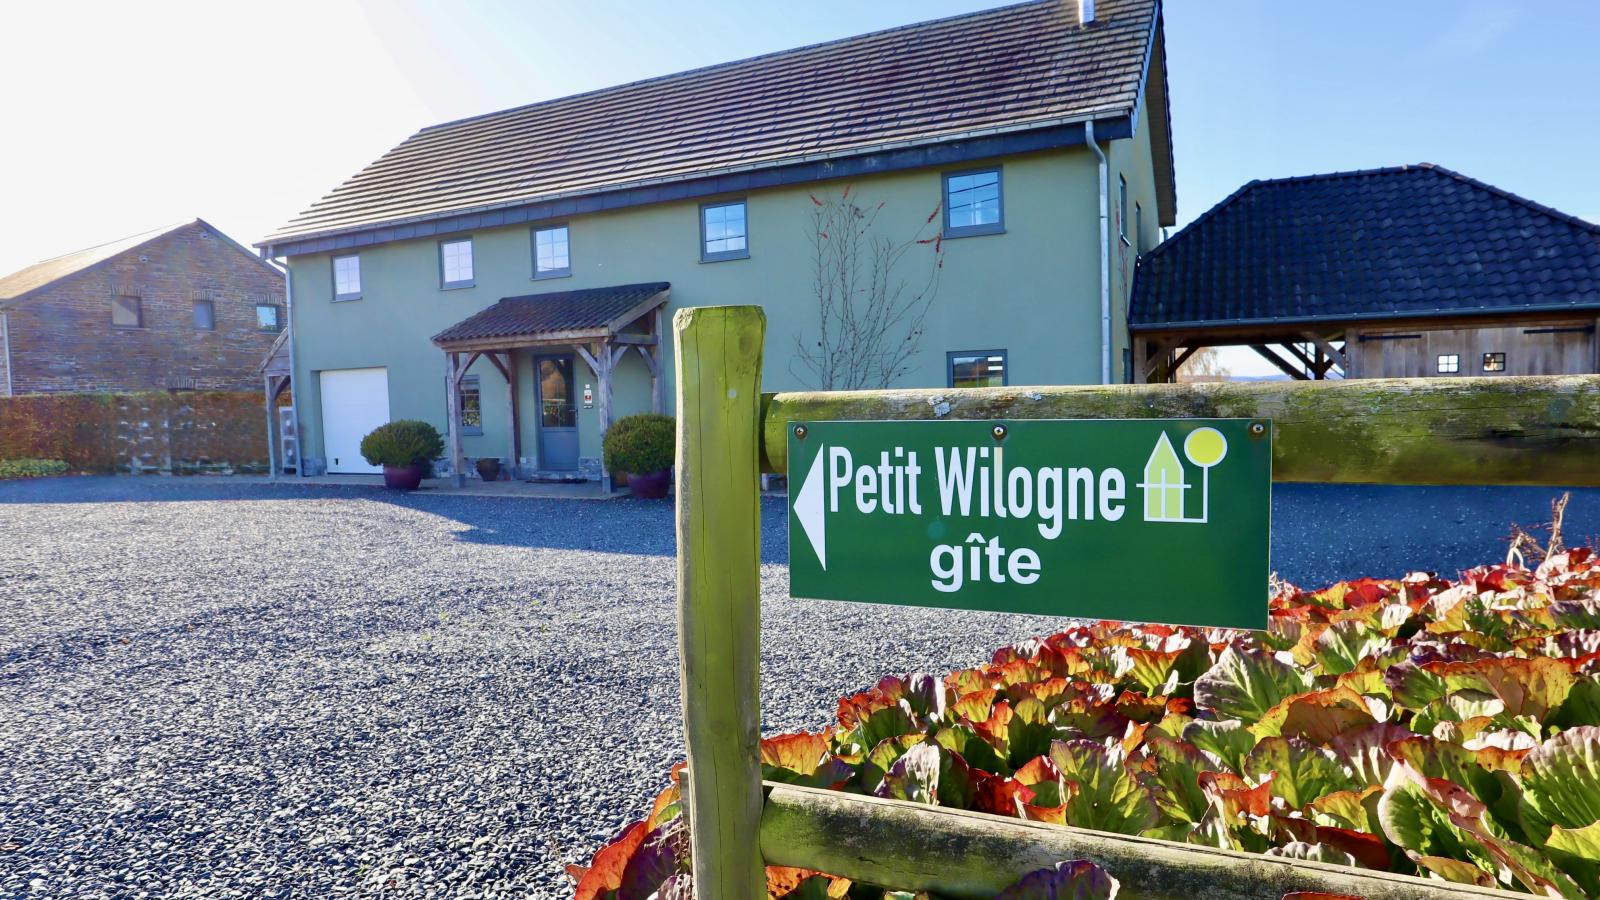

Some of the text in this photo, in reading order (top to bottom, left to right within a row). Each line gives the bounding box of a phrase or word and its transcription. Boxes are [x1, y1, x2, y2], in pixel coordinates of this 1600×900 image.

[829, 446, 1126, 540] Petit Wilogne
[929, 532, 1042, 593] gîte
